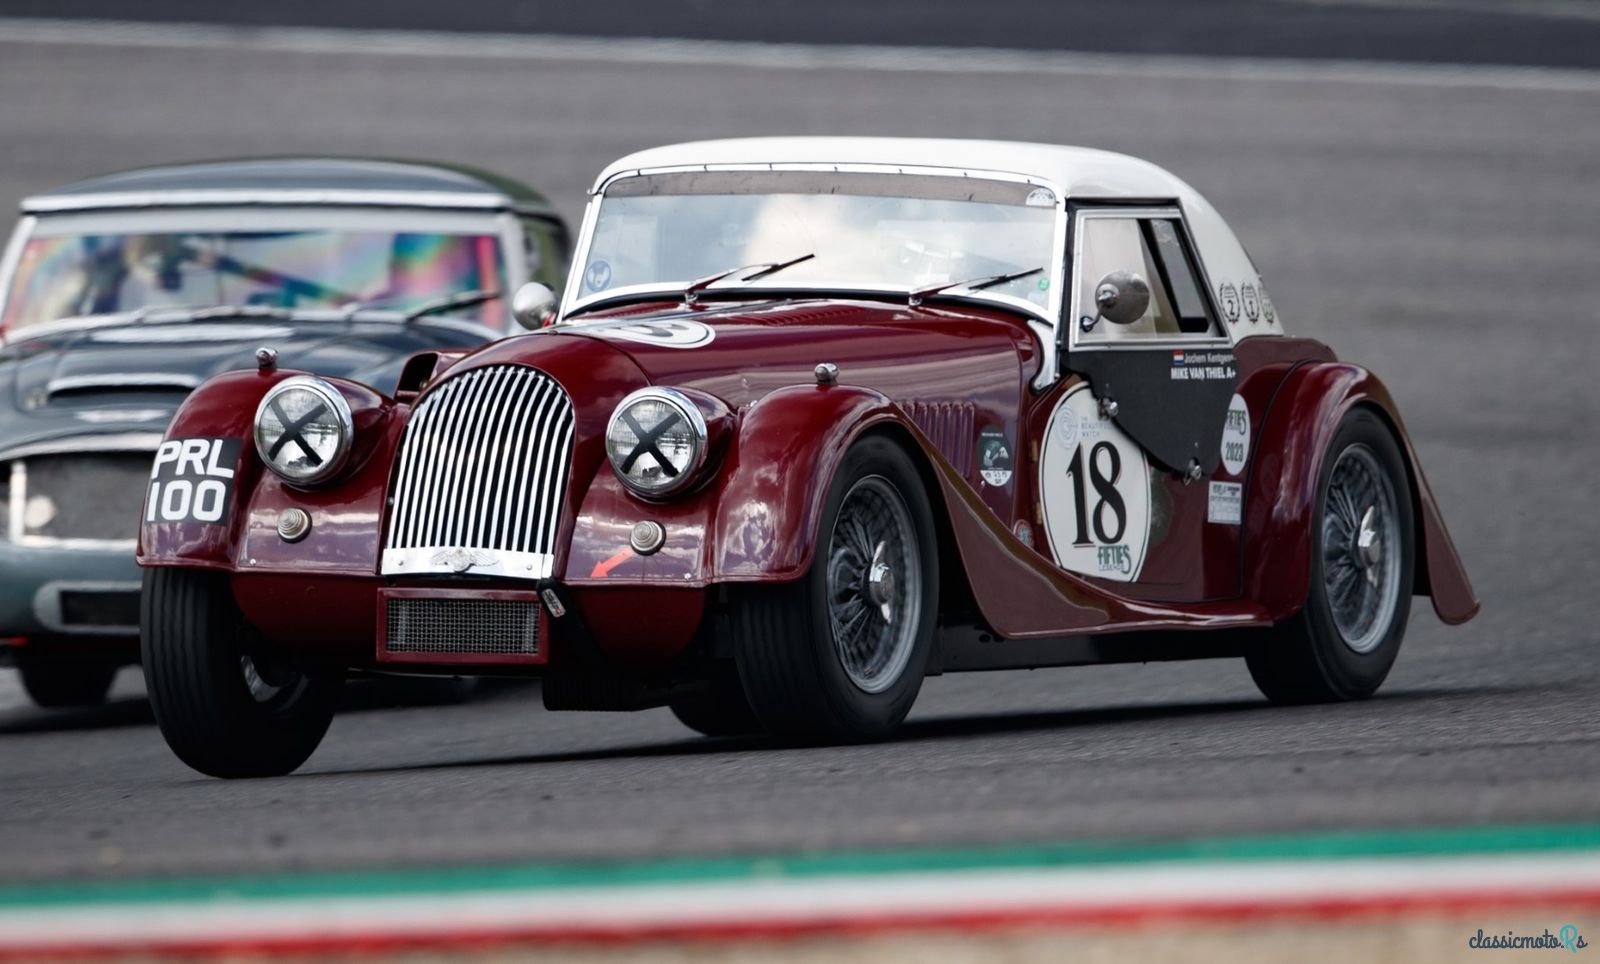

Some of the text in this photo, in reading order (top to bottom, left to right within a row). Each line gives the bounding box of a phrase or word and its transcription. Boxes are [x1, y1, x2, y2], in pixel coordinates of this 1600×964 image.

[1227, 299, 1235, 316] 2
[1171, 367, 1189, 379] MIKE
[1189, 367, 1205, 380] VAN
[1205, 367, 1225, 379] THIEL
[151, 438, 235, 479] PRL
[1225, 442, 1243, 462] 2023
[147, 480, 226, 522] 100
[1066, 440, 1127, 546] 18
[1098, 545, 1132, 574] FIFTIES
